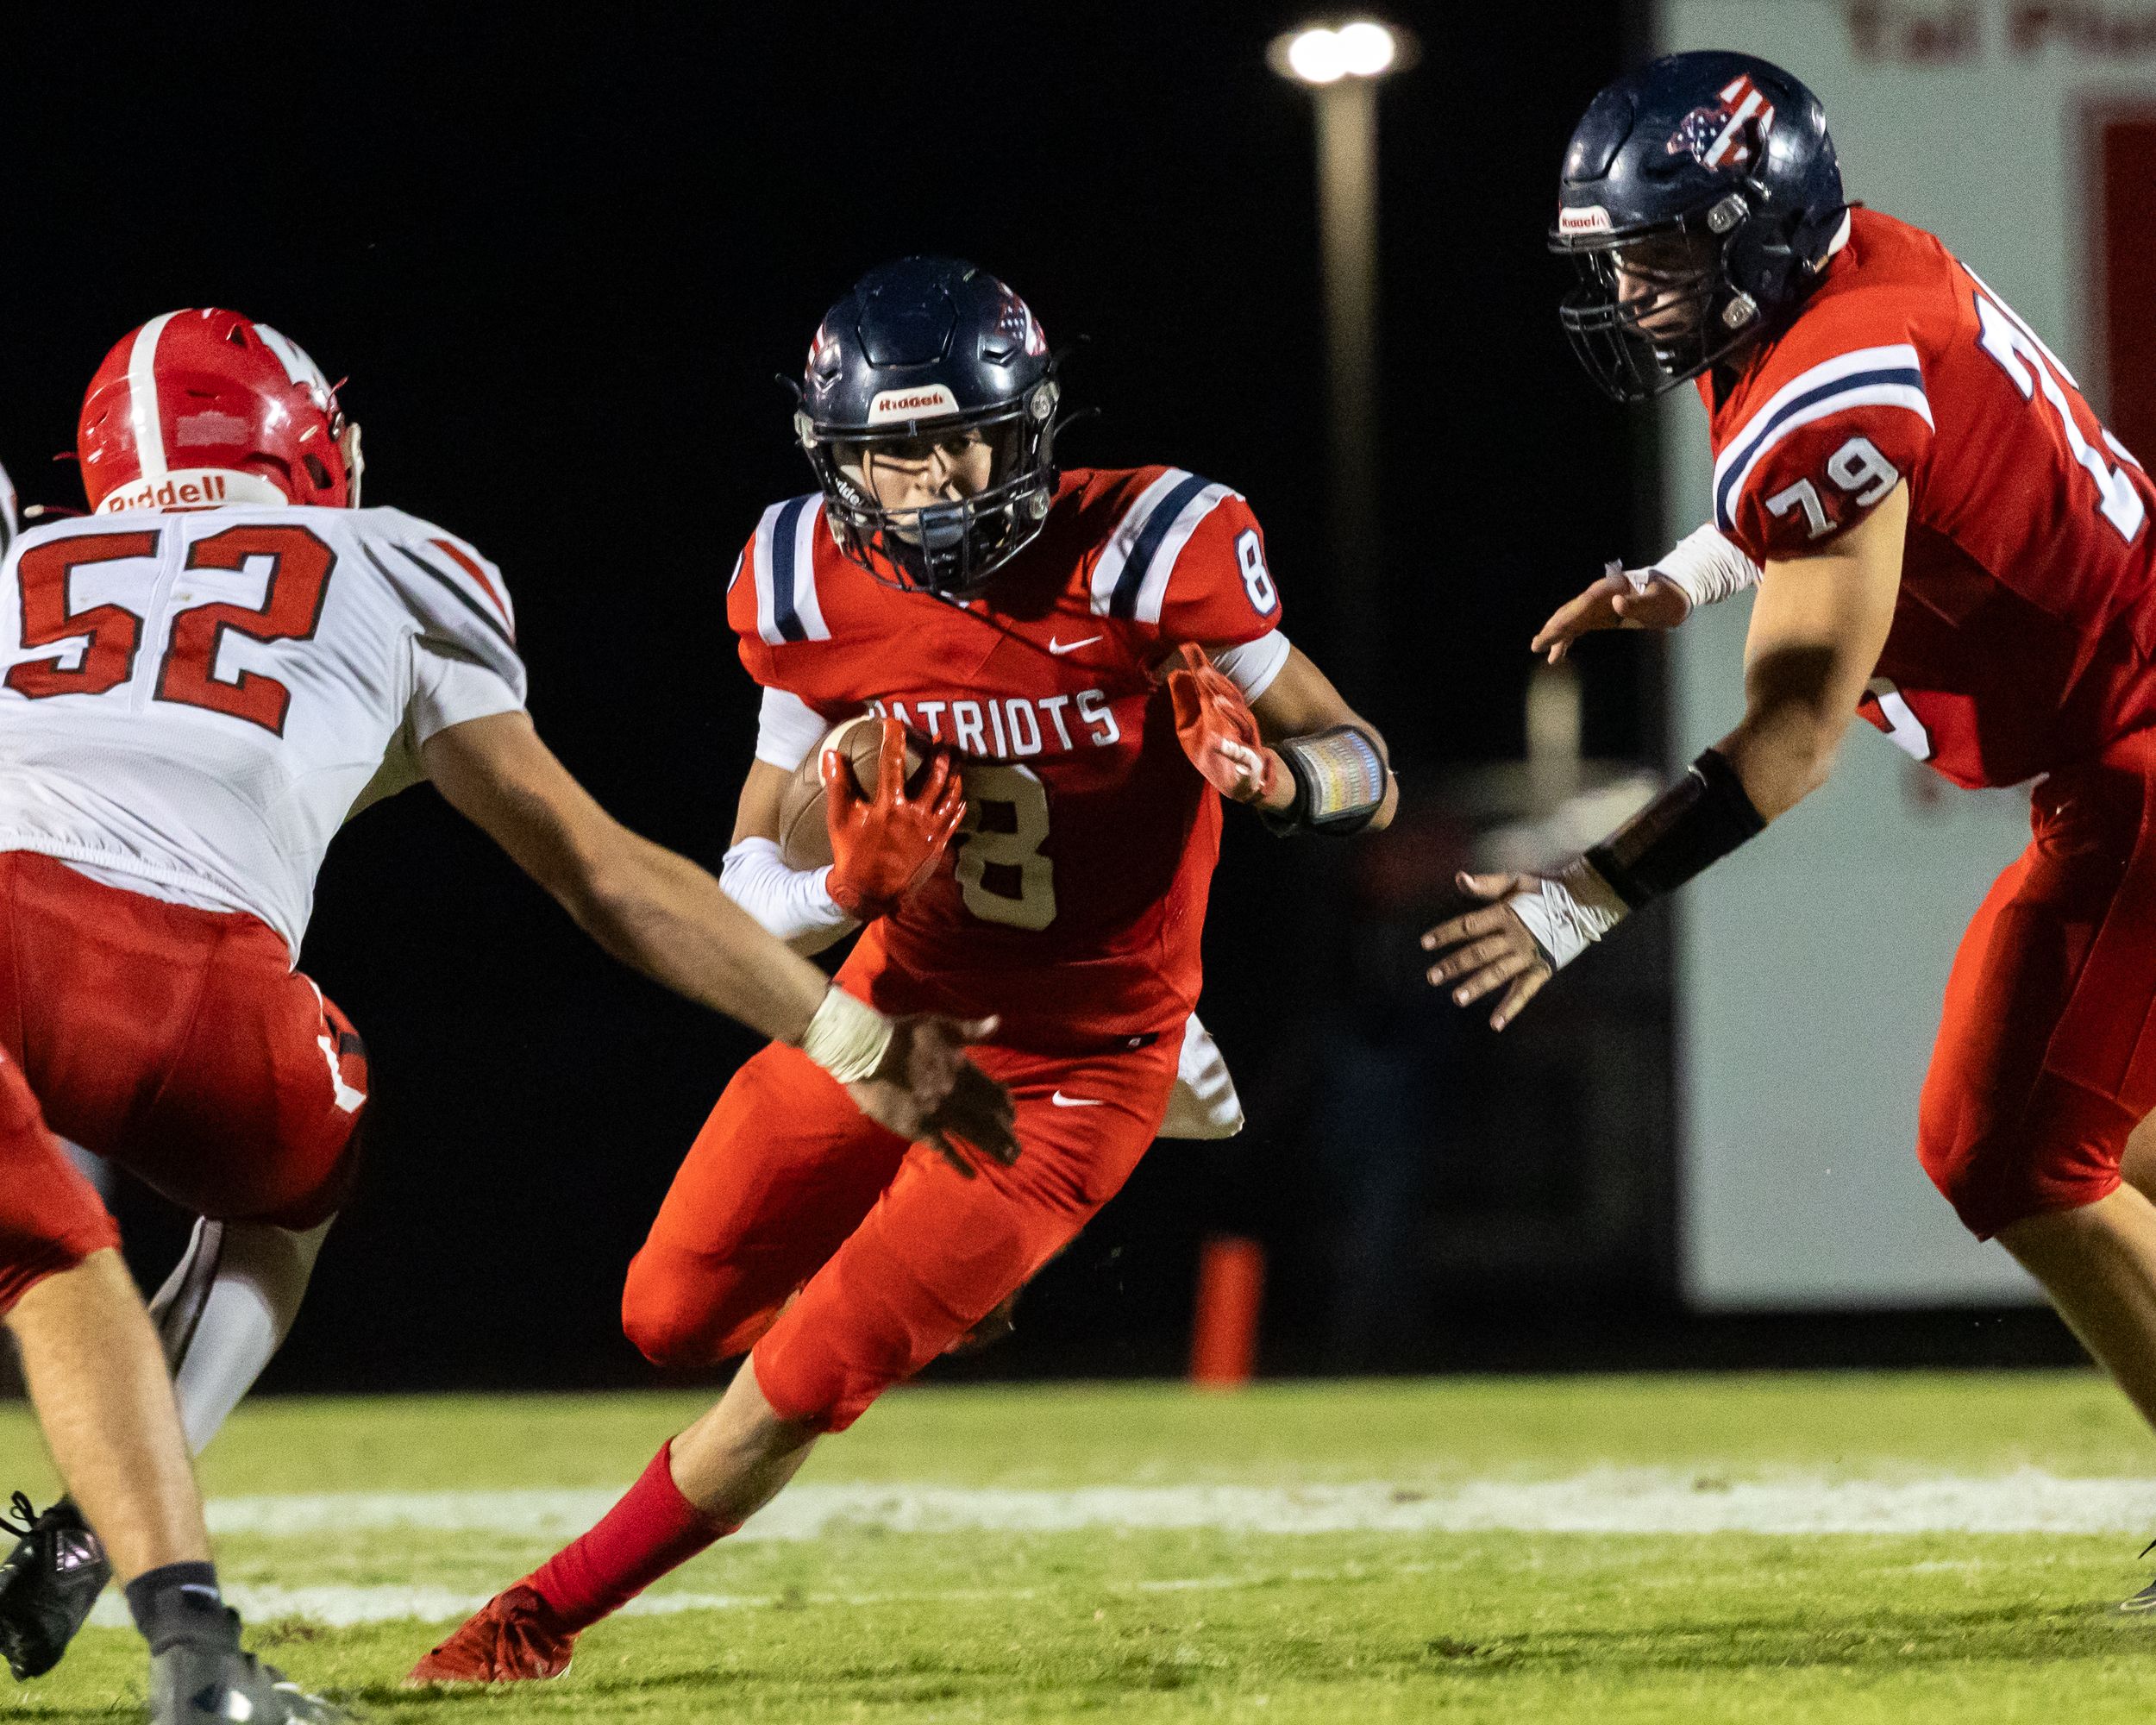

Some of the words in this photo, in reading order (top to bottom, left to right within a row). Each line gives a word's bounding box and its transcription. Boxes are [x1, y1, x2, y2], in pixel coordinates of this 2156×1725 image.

[1764, 436, 1899, 541] 79
[3, 524, 338, 739] 52
[1232, 527, 1277, 619] 8
[955, 762, 1057, 932] 8
